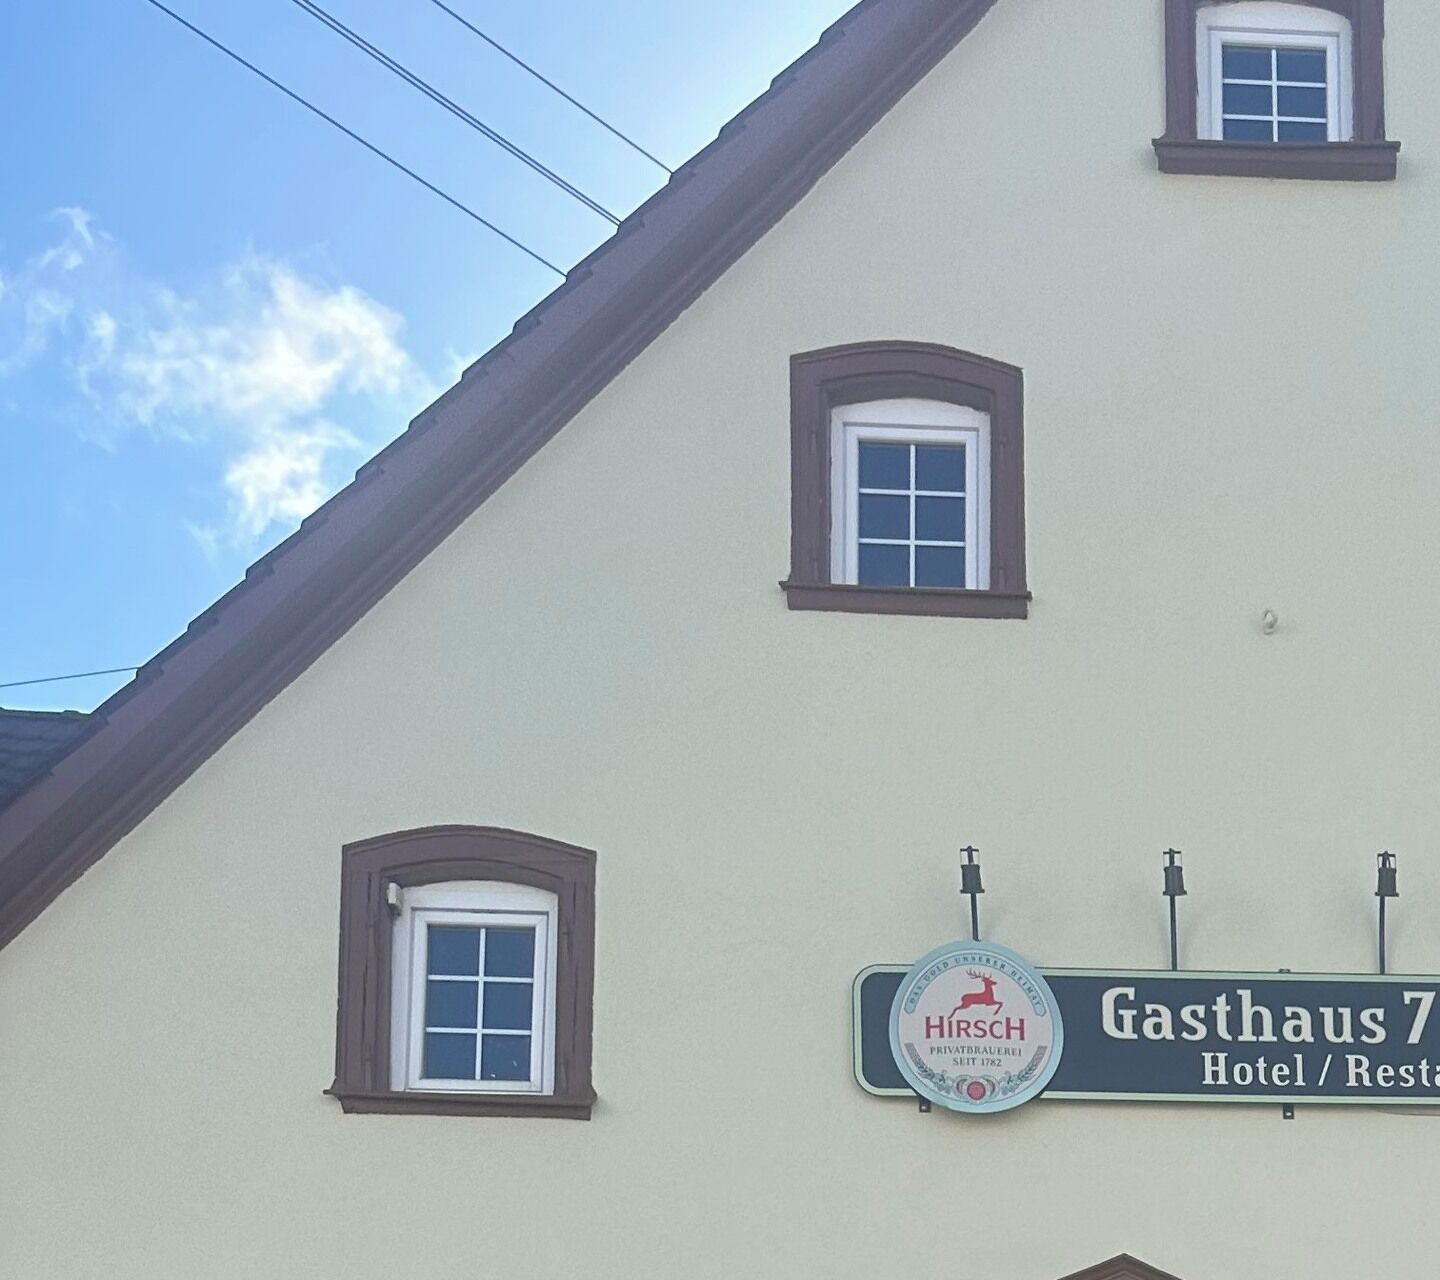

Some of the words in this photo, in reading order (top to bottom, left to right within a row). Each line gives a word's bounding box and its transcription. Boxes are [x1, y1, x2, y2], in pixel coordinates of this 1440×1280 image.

[1102, 986, 1387, 1045] Gasthaus
[1403, 991, 1436, 1045] 7
[925, 1016, 1025, 1041] HIRSCH
[930, 1046, 1022, 1057] PRIVATBRAUEREI
[953, 1058, 977, 1067] SEIT
[981, 1058, 1002, 1067] 1782
[1202, 1052, 1306, 1087] Hotel
[1318, 1053, 1332, 1087] /
